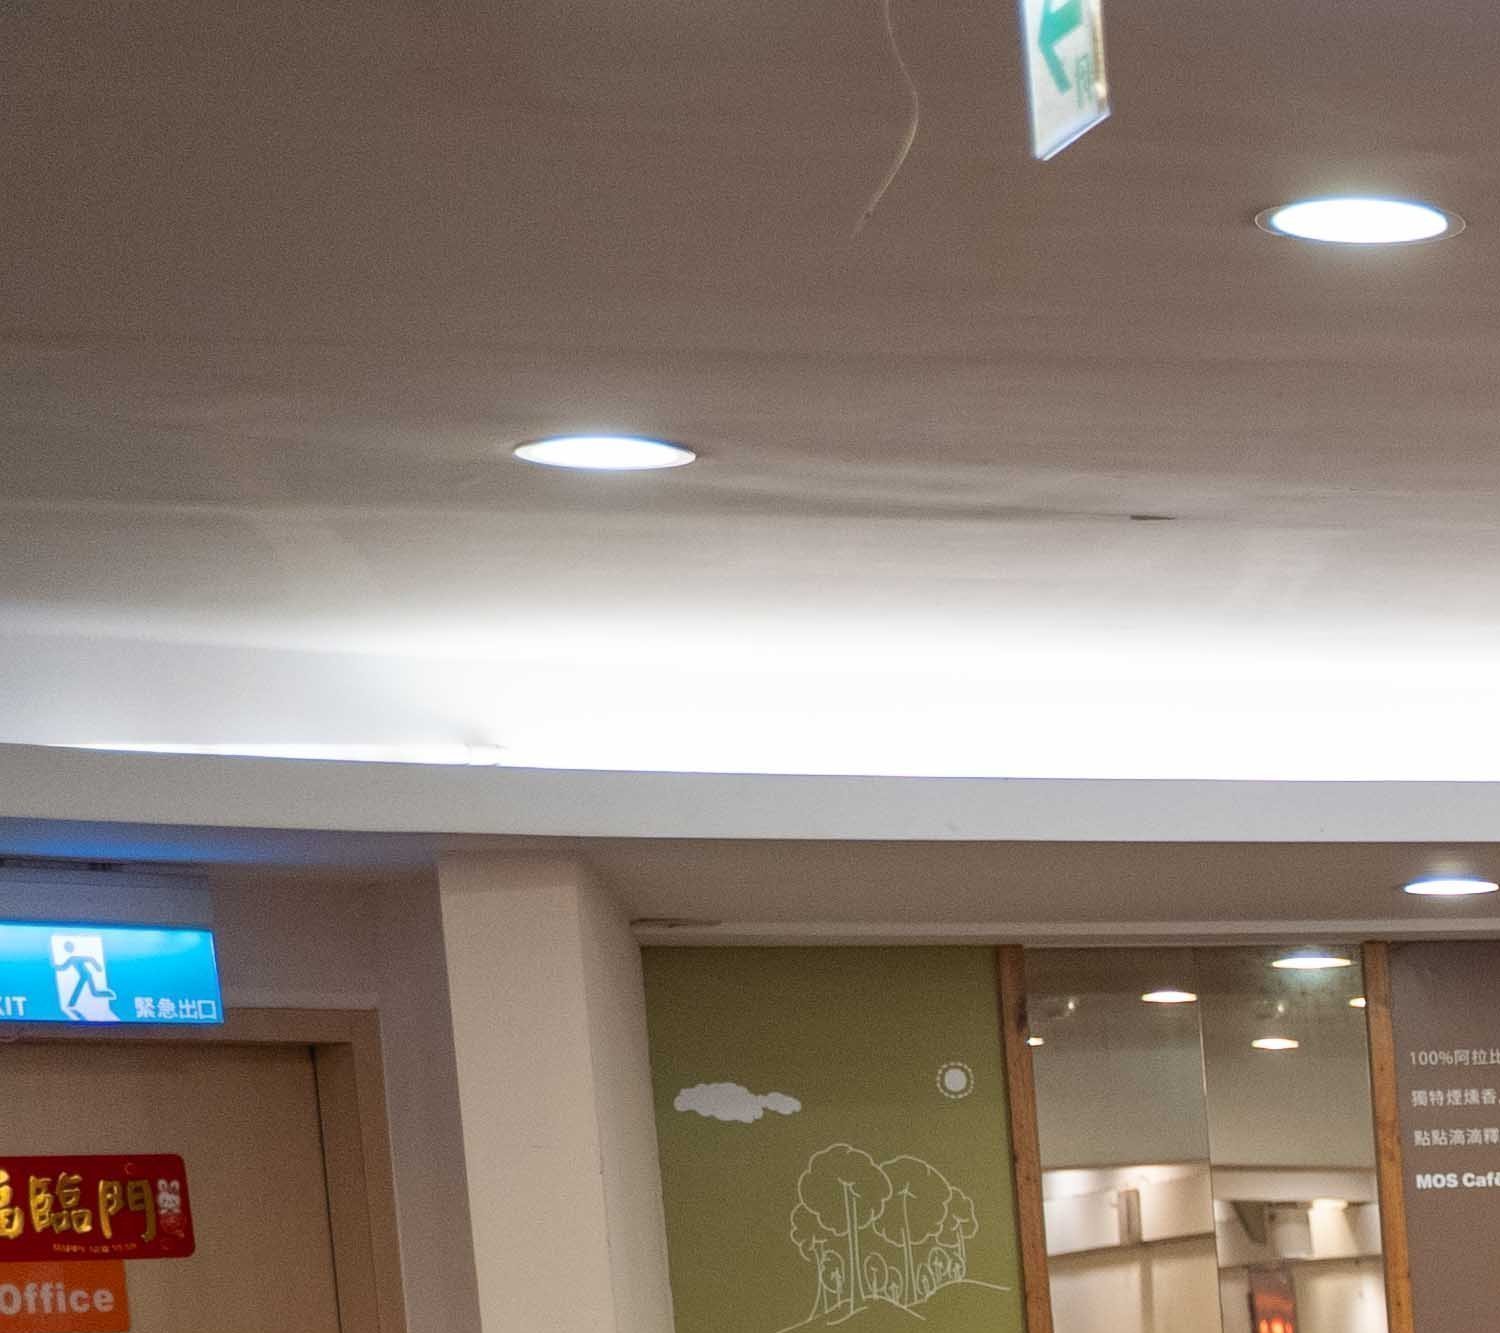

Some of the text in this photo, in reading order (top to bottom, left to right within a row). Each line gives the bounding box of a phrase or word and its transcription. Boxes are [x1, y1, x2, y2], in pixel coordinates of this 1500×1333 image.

[134, 996, 217, 1020] 緊急出口
[1416, 1173, 1458, 1189] MOS
[0, 1281, 115, 1316] Office
